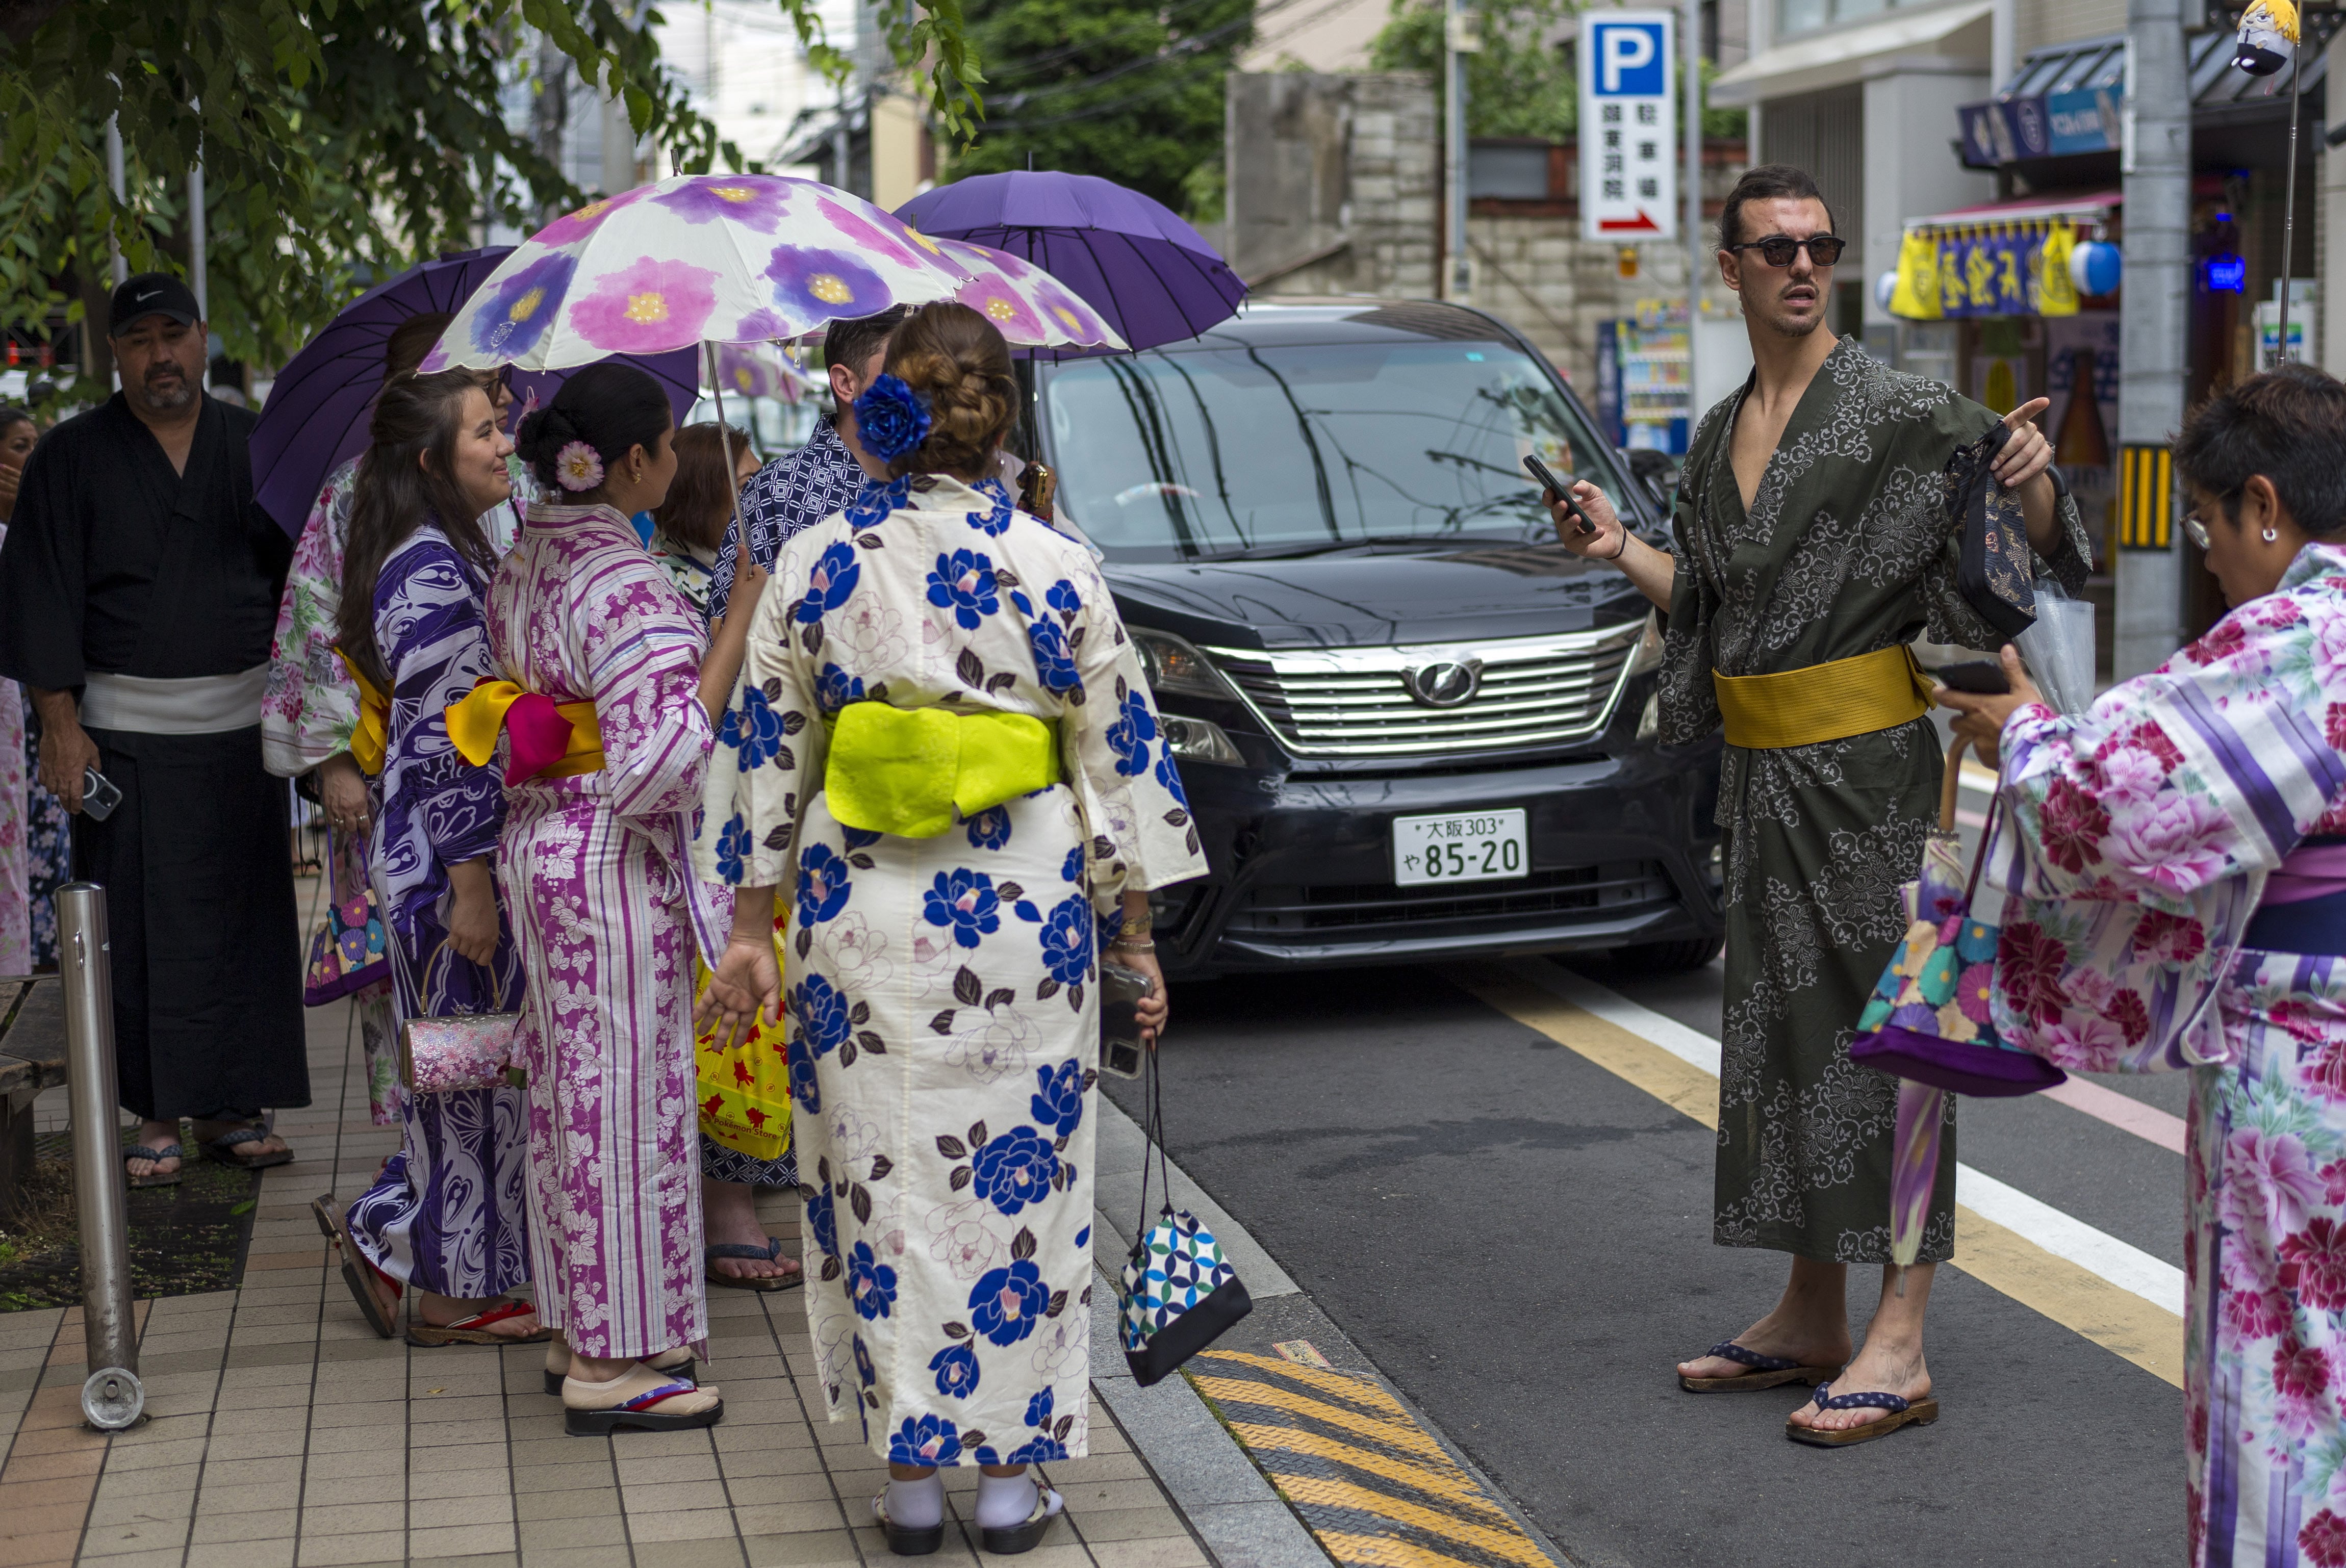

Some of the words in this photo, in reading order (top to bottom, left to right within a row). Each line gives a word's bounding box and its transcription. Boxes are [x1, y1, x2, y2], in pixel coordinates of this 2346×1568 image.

[1602, 28, 1655, 92] P
[1636, 102, 1658, 199] 駐車場
[1404, 854, 1420, 871] や
[1425, 838, 1519, 877] 85-20
[715, 1118, 752, 1134] Pokémon
[754, 1129, 777, 1139] Store
